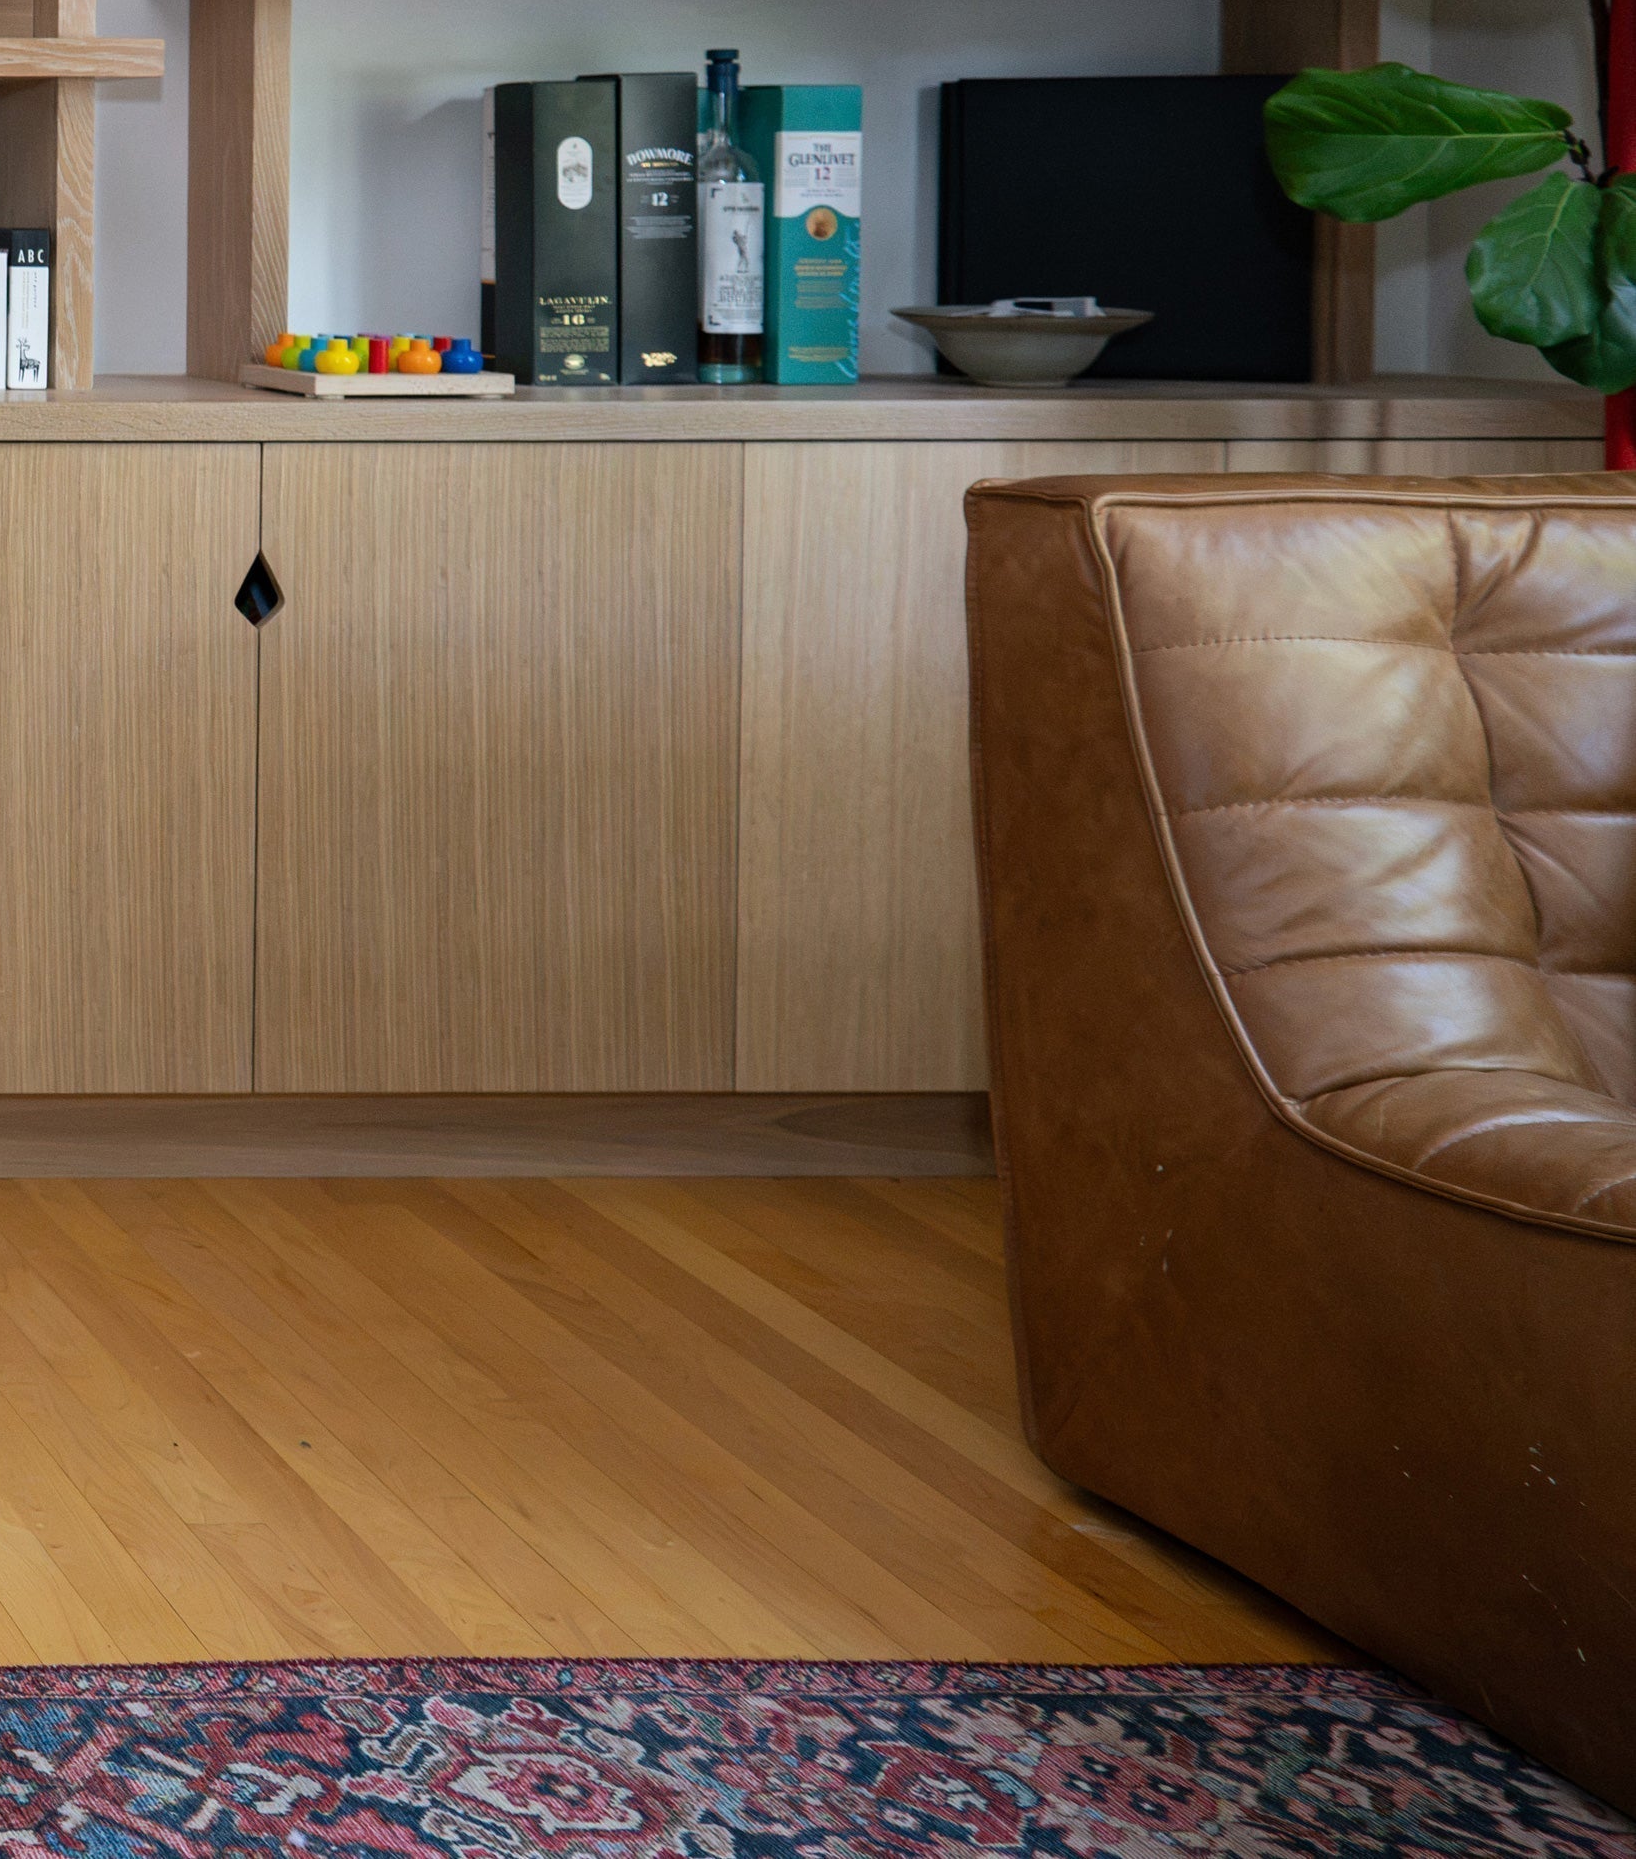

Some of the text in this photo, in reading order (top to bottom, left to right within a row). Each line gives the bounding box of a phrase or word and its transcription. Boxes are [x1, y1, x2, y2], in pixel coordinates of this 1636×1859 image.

[789, 153, 854, 167] GLENLIVET
[814, 167, 830, 181] 12
[651, 192, 668, 206] 12
